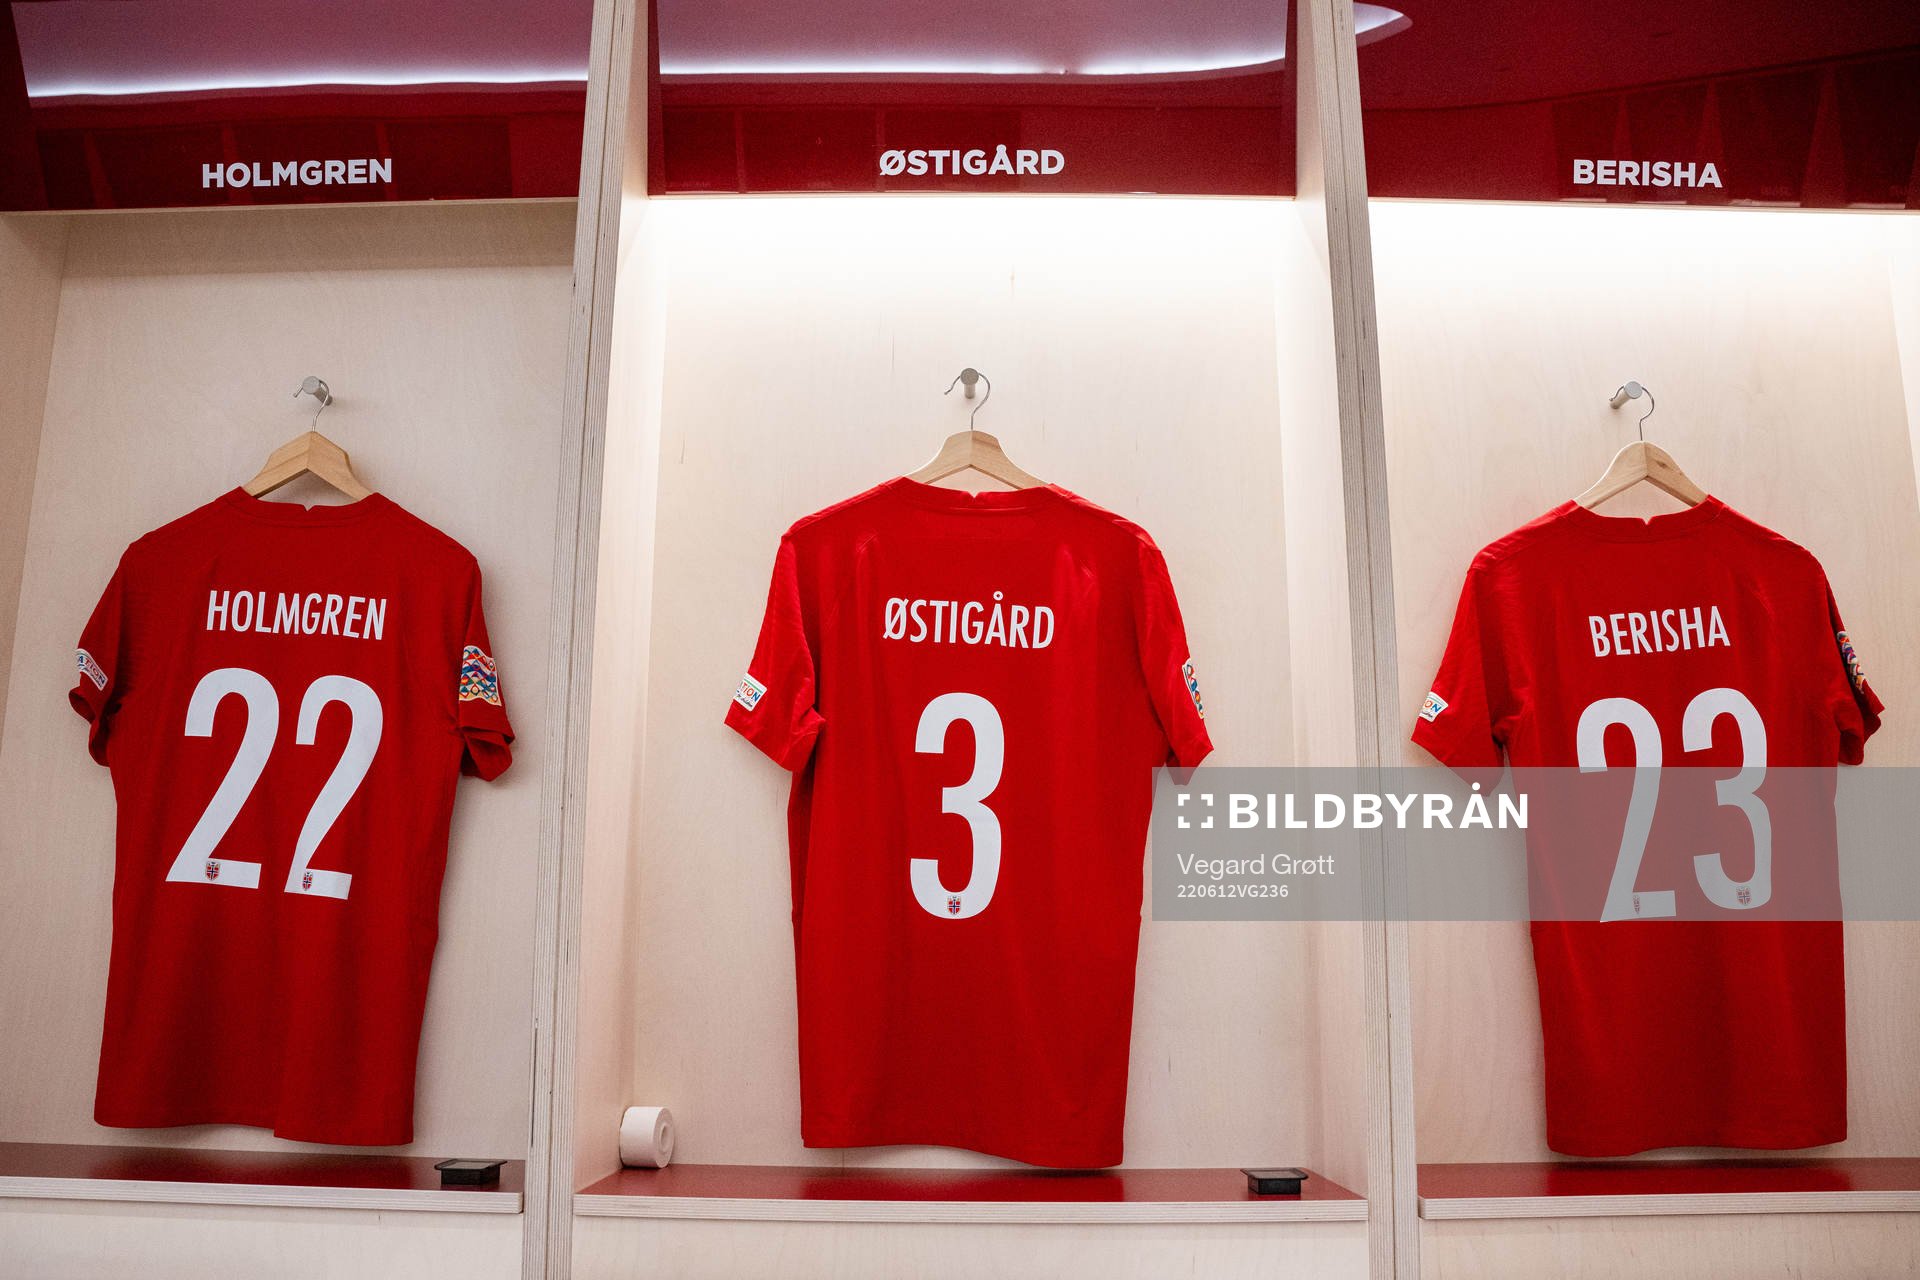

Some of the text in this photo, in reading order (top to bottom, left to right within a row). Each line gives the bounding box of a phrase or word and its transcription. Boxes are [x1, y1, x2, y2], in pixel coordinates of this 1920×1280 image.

[202, 158, 392, 188] HOLMGREN
[879, 145, 1065, 176] ØSTIGÅRD
[1573, 159, 1723, 188] BERISHA
[206, 590, 387, 641] HOLMGREN
[883, 590, 1055, 649] ØSTIGÅRD
[1588, 605, 1730, 658] BERISHA
[165, 667, 384, 900] 22
[909, 692, 1005, 919] 3
[1577, 687, 1772, 922] 23
